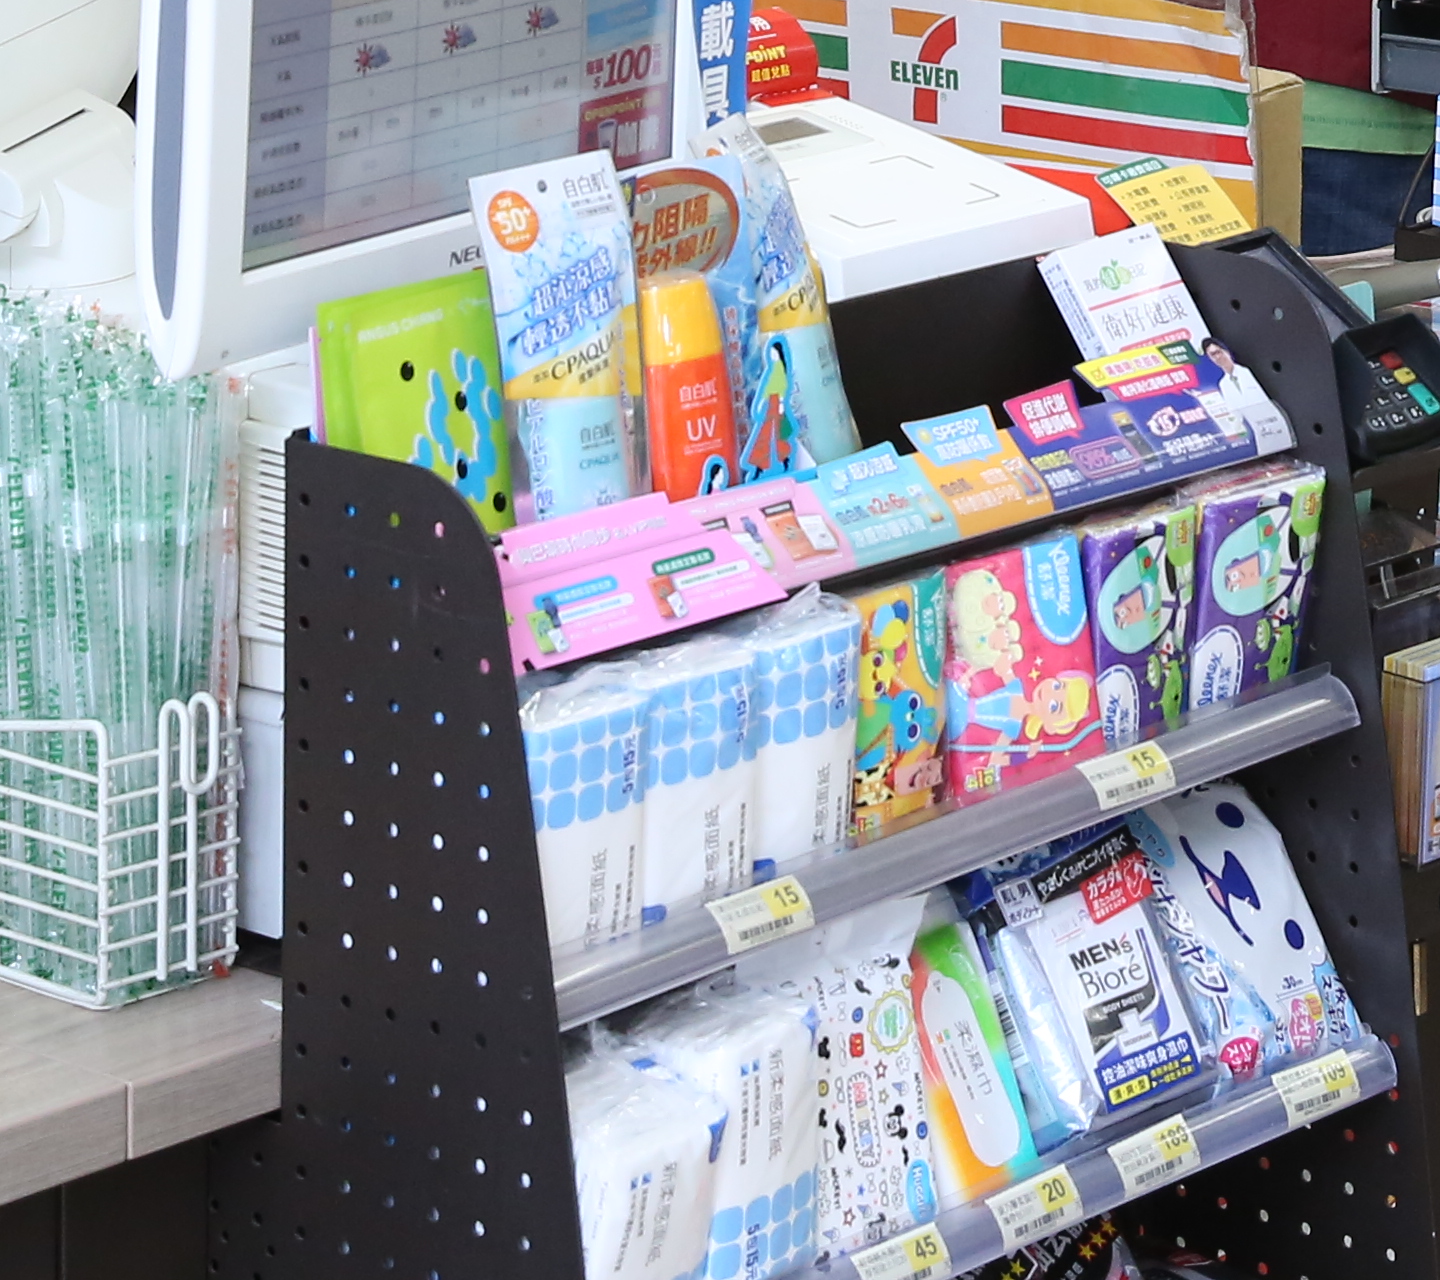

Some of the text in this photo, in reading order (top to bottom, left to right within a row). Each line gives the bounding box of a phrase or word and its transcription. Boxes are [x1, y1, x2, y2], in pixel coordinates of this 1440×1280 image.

[604, 44, 652, 88] 100
[890, 59, 959, 92] ELEVEN
[563, 172, 606, 199] 自白肌
[496, 207, 531, 234] 50+
[679, 381, 717, 402] 自白肌
[687, 416, 716, 440] UV
[1131, 750, 1156, 772] 15
[774, 885, 800, 908] 15
[1042, 1178, 1067, 1203] 20
[915, 1235, 938, 1259] 45
